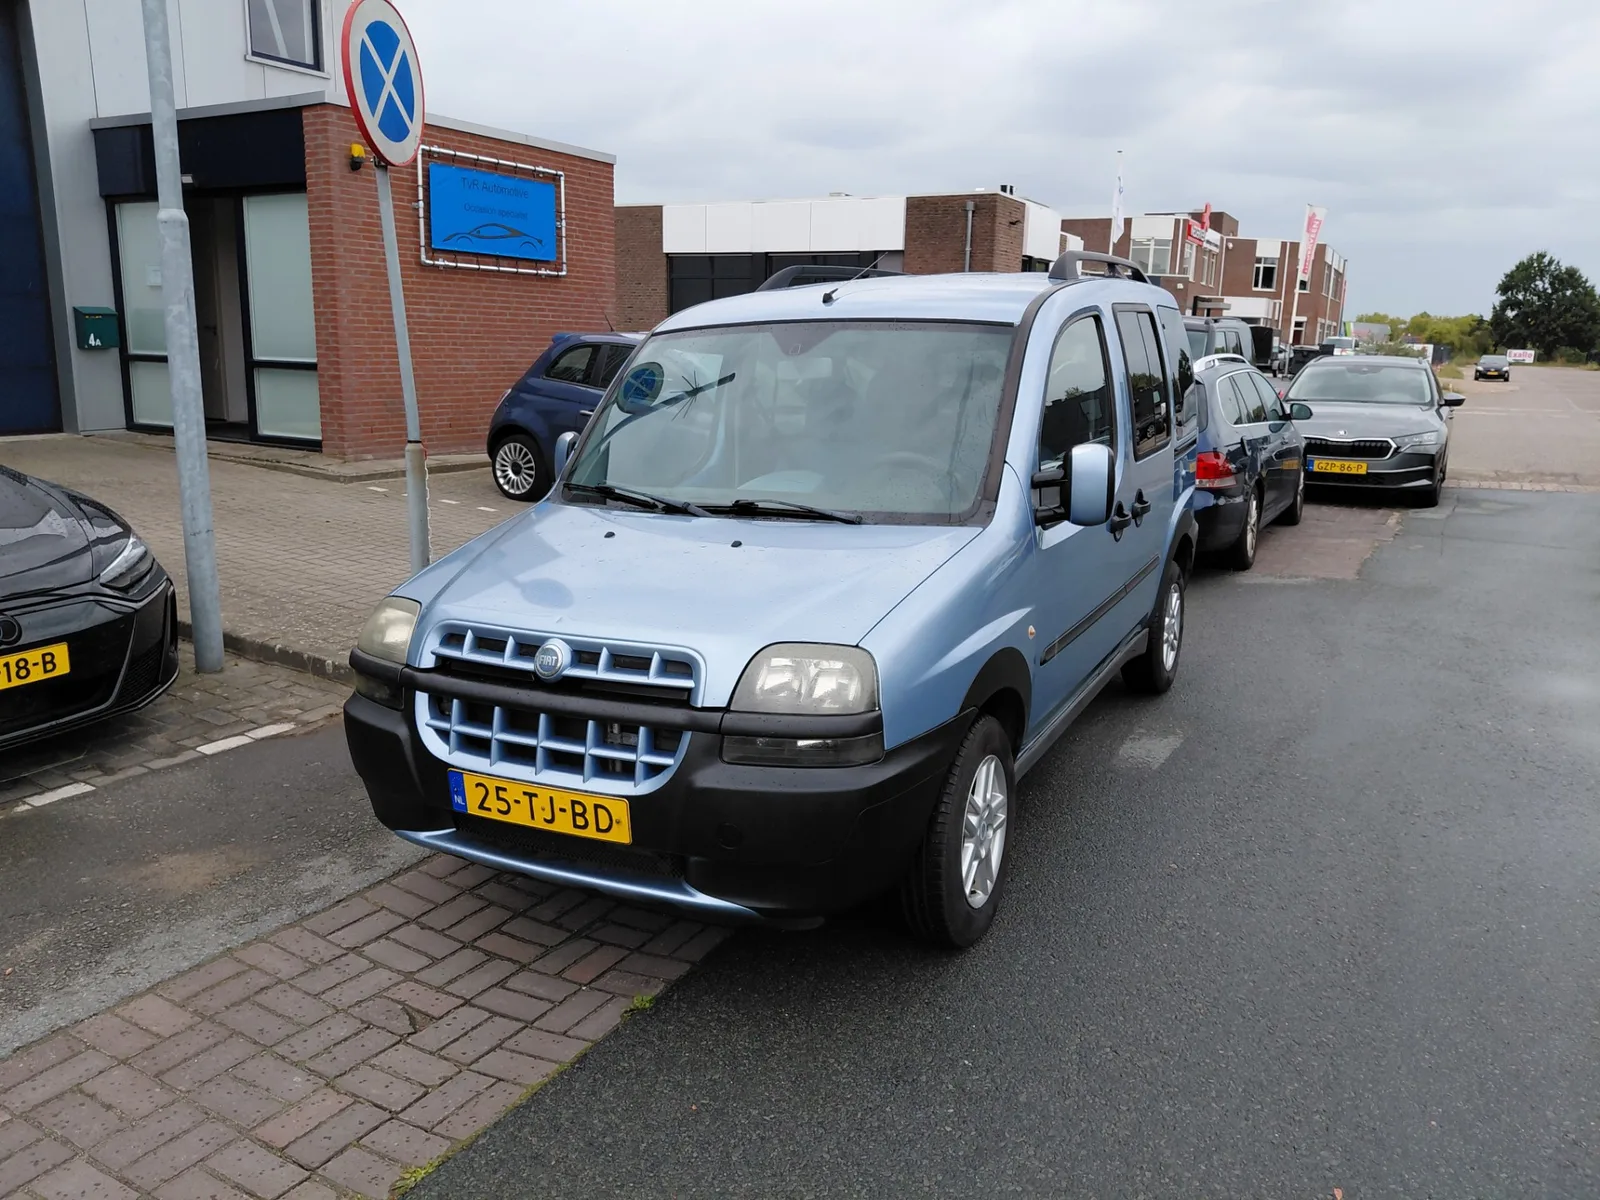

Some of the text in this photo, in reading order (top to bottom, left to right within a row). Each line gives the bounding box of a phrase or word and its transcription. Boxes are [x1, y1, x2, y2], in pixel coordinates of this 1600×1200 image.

[461, 176, 529, 199] TvR Automotive
[1317, 462, 1363, 472] GZP-86-P
[0, 651, 57, 683] 18-B
[540, 654, 558, 667] FIAT
[454, 782, 614, 834] NL 25-TJ-BD
